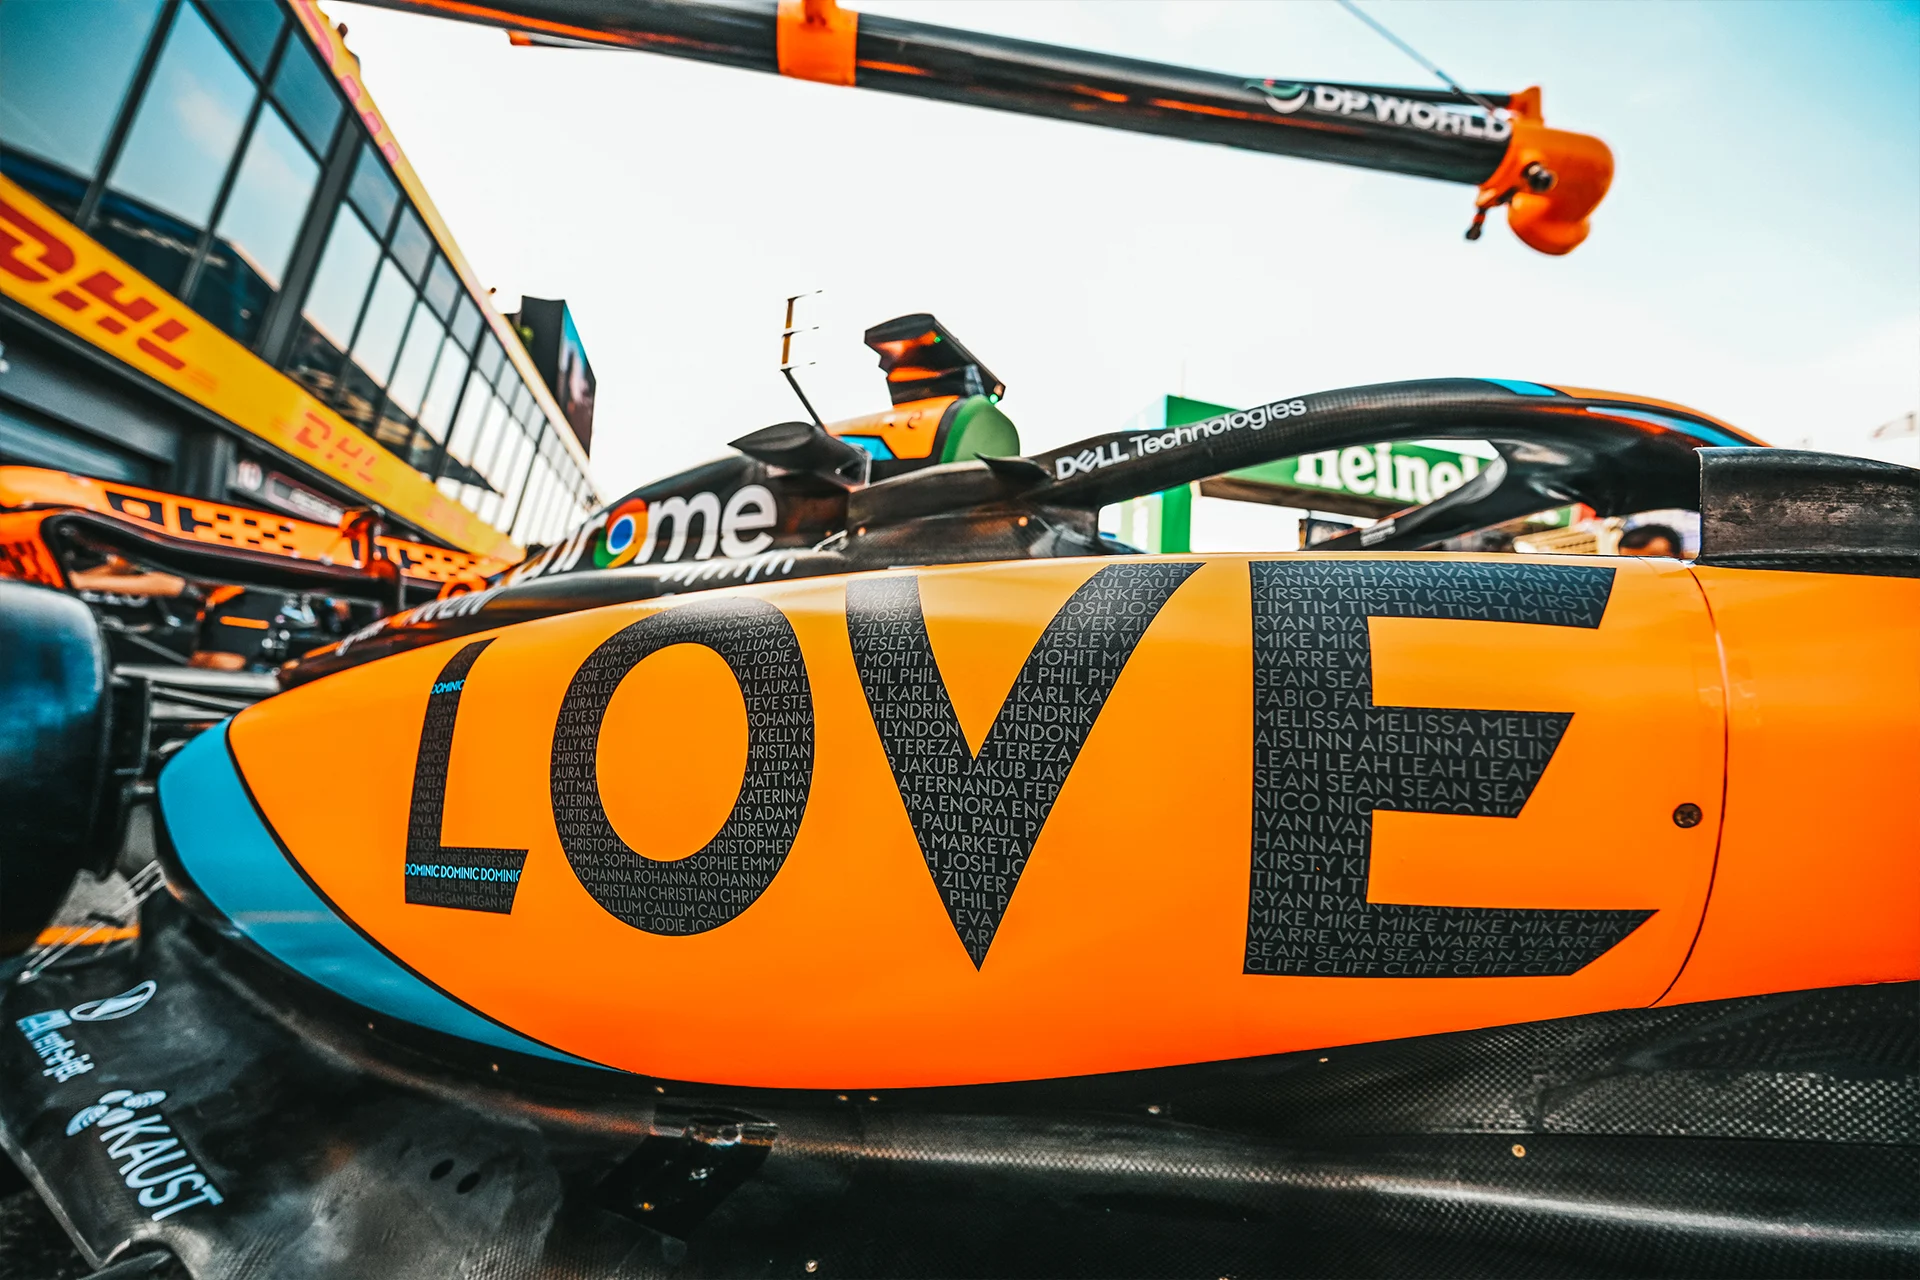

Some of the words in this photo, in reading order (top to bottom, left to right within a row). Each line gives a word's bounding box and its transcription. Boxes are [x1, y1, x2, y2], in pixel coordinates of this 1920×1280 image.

[1313, 84, 1368, 115] DP
[1369, 94, 1512, 142] WORLD
[0, 199, 190, 371] DHL
[1055, 441, 1130, 481] DELL
[1128, 398, 1308, 457] Technologies
[1129, 578, 1177, 588] PAUL
[1252, 567, 1302, 576] IVAN
[1310, 567, 1363, 576] IVAN
[1370, 567, 1428, 577] IVAN
[1432, 568, 1491, 578] IVAN
[1496, 570, 1558, 582] IVAN
[1071, 588, 1168, 600] MARKETA
[1252, 576, 1355, 588] HANNAH
[1361, 577, 1470, 589] HANNAH
[1477, 579, 1595, 596] HANNAH
[1253, 587, 1330, 600] KIRSTY
[1338, 588, 1419, 601] KIRSTY
[1427, 589, 1511, 605] KIRSTY
[866, 608, 912, 622] JOSH
[1057, 601, 1112, 615] JOSH
[1254, 601, 1293, 614] TIM
[1298, 601, 1340, 615] TIM
[1345, 601, 1388, 615] TIM
[1393, 602, 1438, 615] TIM
[1442, 603, 1489, 618] TIM
[1493, 605, 1540, 621] TIM
[1545, 609, 1594, 626] TIM
[644, 620, 725, 639] CHRISTOPHER
[856, 621, 912, 636] ZILVER
[1049, 616, 1117, 631] ZILVER
[1255, 615, 1315, 631] RYAN
[721, 639, 775, 654] CALLUM
[854, 635, 919, 651] WESLEY
[1255, 632, 1312, 648] MIKE
[750, 649, 792, 665] JODIE
[864, 651, 921, 667] MOHIT
[1254, 650, 1340, 668] WARRE
[754, 664, 797, 679] LEENA
[861, 668, 896, 684] PHIL
[900, 668, 937, 683] PHIL
[1038, 667, 1082, 685] PHIL
[1255, 668, 1318, 687] SEAN
[754, 679, 799, 695] LAURA
[887, 686, 932, 701] KARL
[1018, 685, 1069, 703] KARL
[746, 696, 779, 711] TEVE
[1256, 688, 1326, 708] FABIO
[558, 710, 587, 724] STEVE
[748, 711, 813, 727] ROHANNA
[873, 703, 951, 719] HENDRIK
[1000, 704, 1093, 725] HENDRIK
[884, 721, 959, 737] LYNDON
[1256, 709, 1359, 731] MELISSA
[1365, 712, 1475, 736] MELISSA
[759, 727, 799, 742] KELLY
[993, 722, 1080, 743] LYNDON
[895, 739, 963, 756] TEREZA
[994, 741, 1072, 762] TEREZA
[1254, 729, 1353, 750] AISLINN
[1359, 734, 1463, 756] AISLINN
[900, 757, 958, 774] JAKUB
[962, 758, 1026, 779] JAKUB
[1255, 749, 1317, 770] LEAH
[1326, 752, 1390, 774] LEAH
[1400, 756, 1466, 779] LEAH
[1475, 760, 1543, 782] LEAH
[551, 780, 576, 792] MATT
[744, 772, 779, 788] MATT
[915, 776, 1019, 798] FERNANDA
[1254, 769, 1319, 791] SEAN
[1326, 773, 1393, 795] SEAN
[1401, 778, 1470, 800] SEAN
[553, 794, 601, 807] KATERINA
[738, 788, 806, 804] KATERINA
[1254, 790, 1321, 812] NICO
[554, 809, 589, 821] CURTIS
[754, 806, 797, 820] ADAM
[939, 795, 1007, 817] ENORA
[559, 823, 604, 836] ANDREW
[718, 823, 779, 837] ANDREW
[923, 812, 967, 832] PAUL
[972, 816, 1020, 837] PAUL
[1255, 811, 1311, 832] IVAN
[1320, 815, 1372, 836] IVAN
[562, 837, 631, 852] CHRISTOPHE
[932, 832, 1023, 857] MARKETA
[1254, 830, 1364, 856] HANNAH
[568, 852, 645, 868] EMMA-SOPHIE
[943, 853, 995, 873] JOSH
[1254, 850, 1336, 873] KIRSTY
[405, 864, 440, 878] DOMINIC
[440, 865, 479, 880] DOMINIC
[481, 867, 521, 882] DOMINIC
[576, 867, 632, 883] ROHANNA
[634, 870, 698, 886] ROHANNA
[700, 872, 769, 888] ROHANNA
[942, 870, 1007, 893] ZILVER
[1253, 870, 1293, 889] TIM
[1299, 874, 1341, 893] TIM
[459, 881, 477, 893] PHIL
[479, 882, 498, 895] PHIL
[587, 882, 646, 899] CHRISTIAN
[649, 886, 717, 902] CHRISTIAN
[465, 894, 498, 908] MEGAN
[950, 890, 992, 910] PHIL
[1252, 889, 1313, 909] RYAN
[644, 901, 695, 917] CALLUM
[649, 918, 686, 932] JODIE
[956, 909, 994, 928] EVA
[1250, 908, 1307, 927] MIKE
[1314, 913, 1372, 929] MIKE
[1378, 916, 1438, 933] MIKE
[1444, 918, 1505, 934] MIKE
[1510, 920, 1572, 934] MIKE
[1249, 924, 1331, 944] WARRE
[1337, 930, 1421, 947] WARRE
[1427, 934, 1512, 949] WARRE
[1519, 935, 1605, 949] WARRE
[1247, 941, 1308, 958] SEAN
[1314, 945, 1377, 960] SEAN
[1382, 948, 1446, 962] SEAN
[1451, 950, 1516, 963] SEAN
[1520, 950, 1582, 962] SEAN
[1246, 957, 1308, 972] CLIFF
[1314, 960, 1378, 974] CLIFF
[1383, 962, 1448, 975] CLIFF
[1453, 963, 1520, 975] CLIFF
[100, 1114, 224, 1221] KAUST
